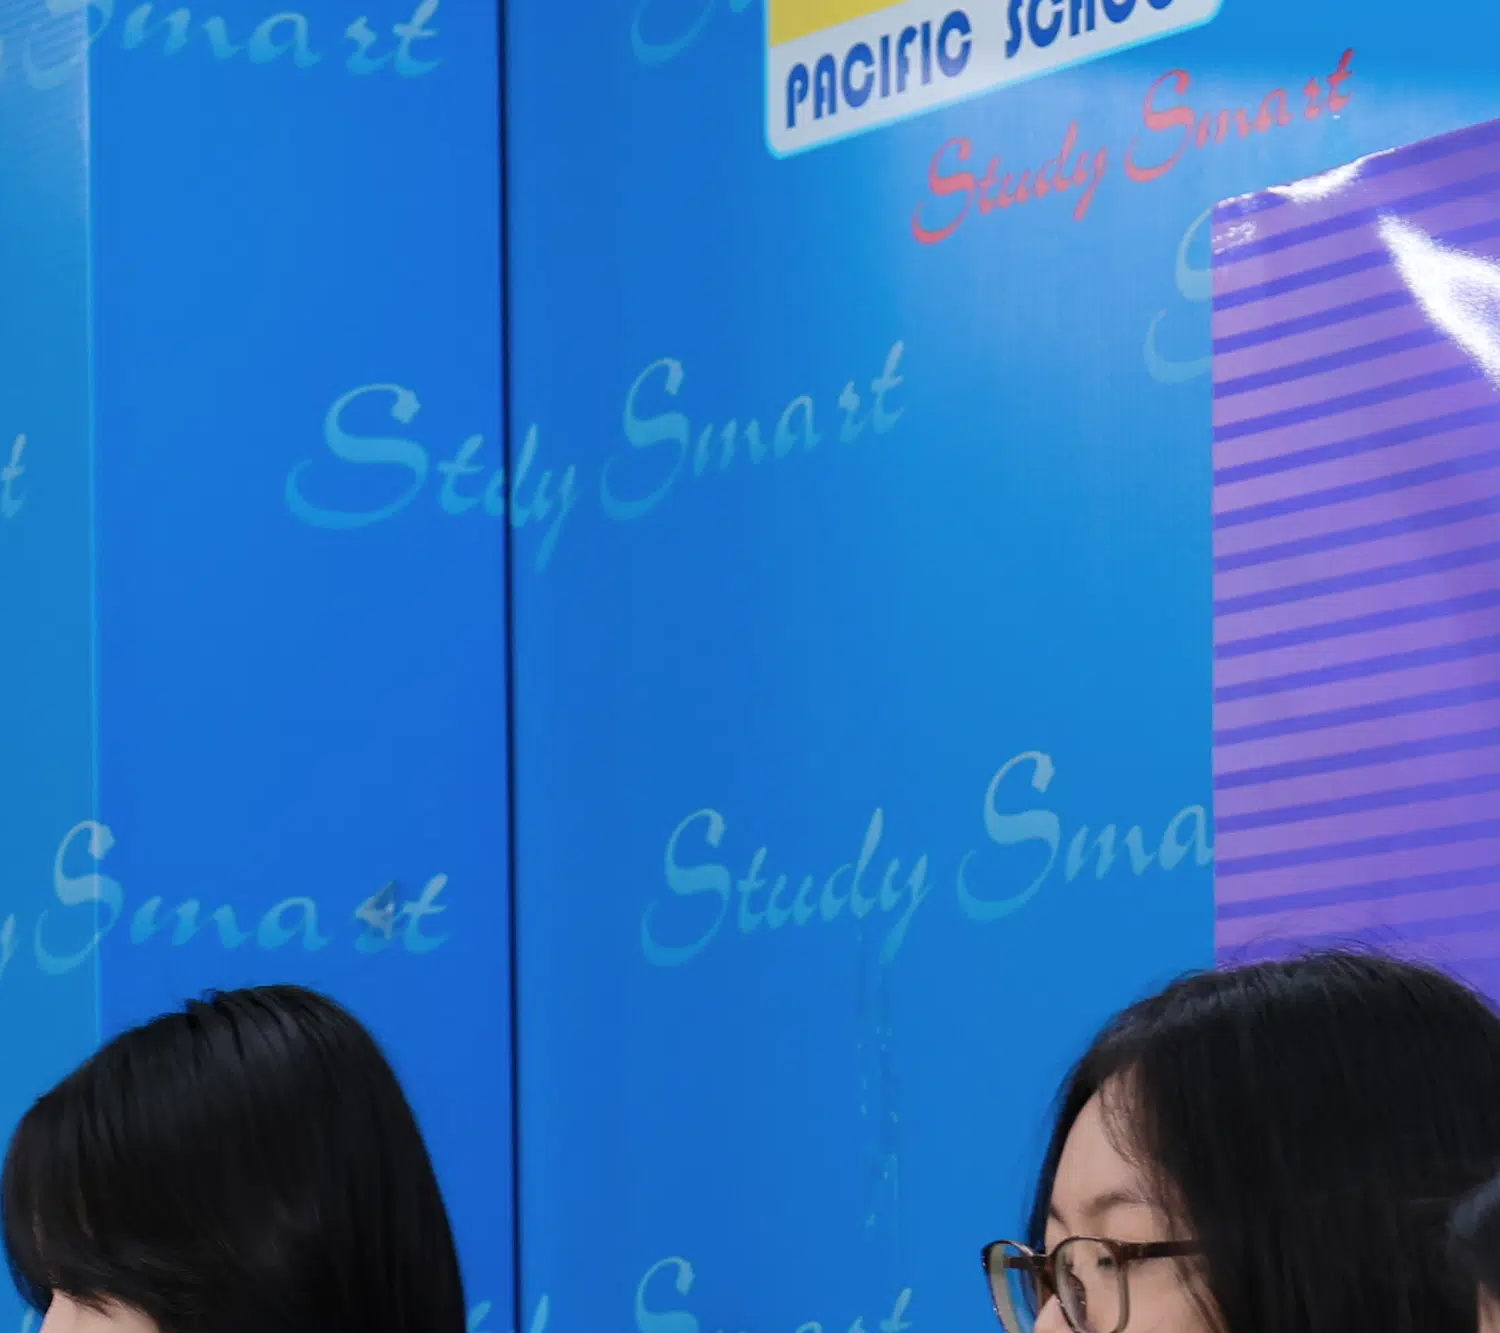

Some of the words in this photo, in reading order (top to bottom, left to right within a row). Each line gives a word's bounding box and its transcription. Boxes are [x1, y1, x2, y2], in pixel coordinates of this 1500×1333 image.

[786, 9, 972, 130] PACIFIC
[911, 120, 1108, 245] Study
[1123, 48, 1357, 184] Smart
[600, 340, 905, 521] Smart
[639, 806, 933, 968] Study
[955, 749, 1215, 922] Sma
